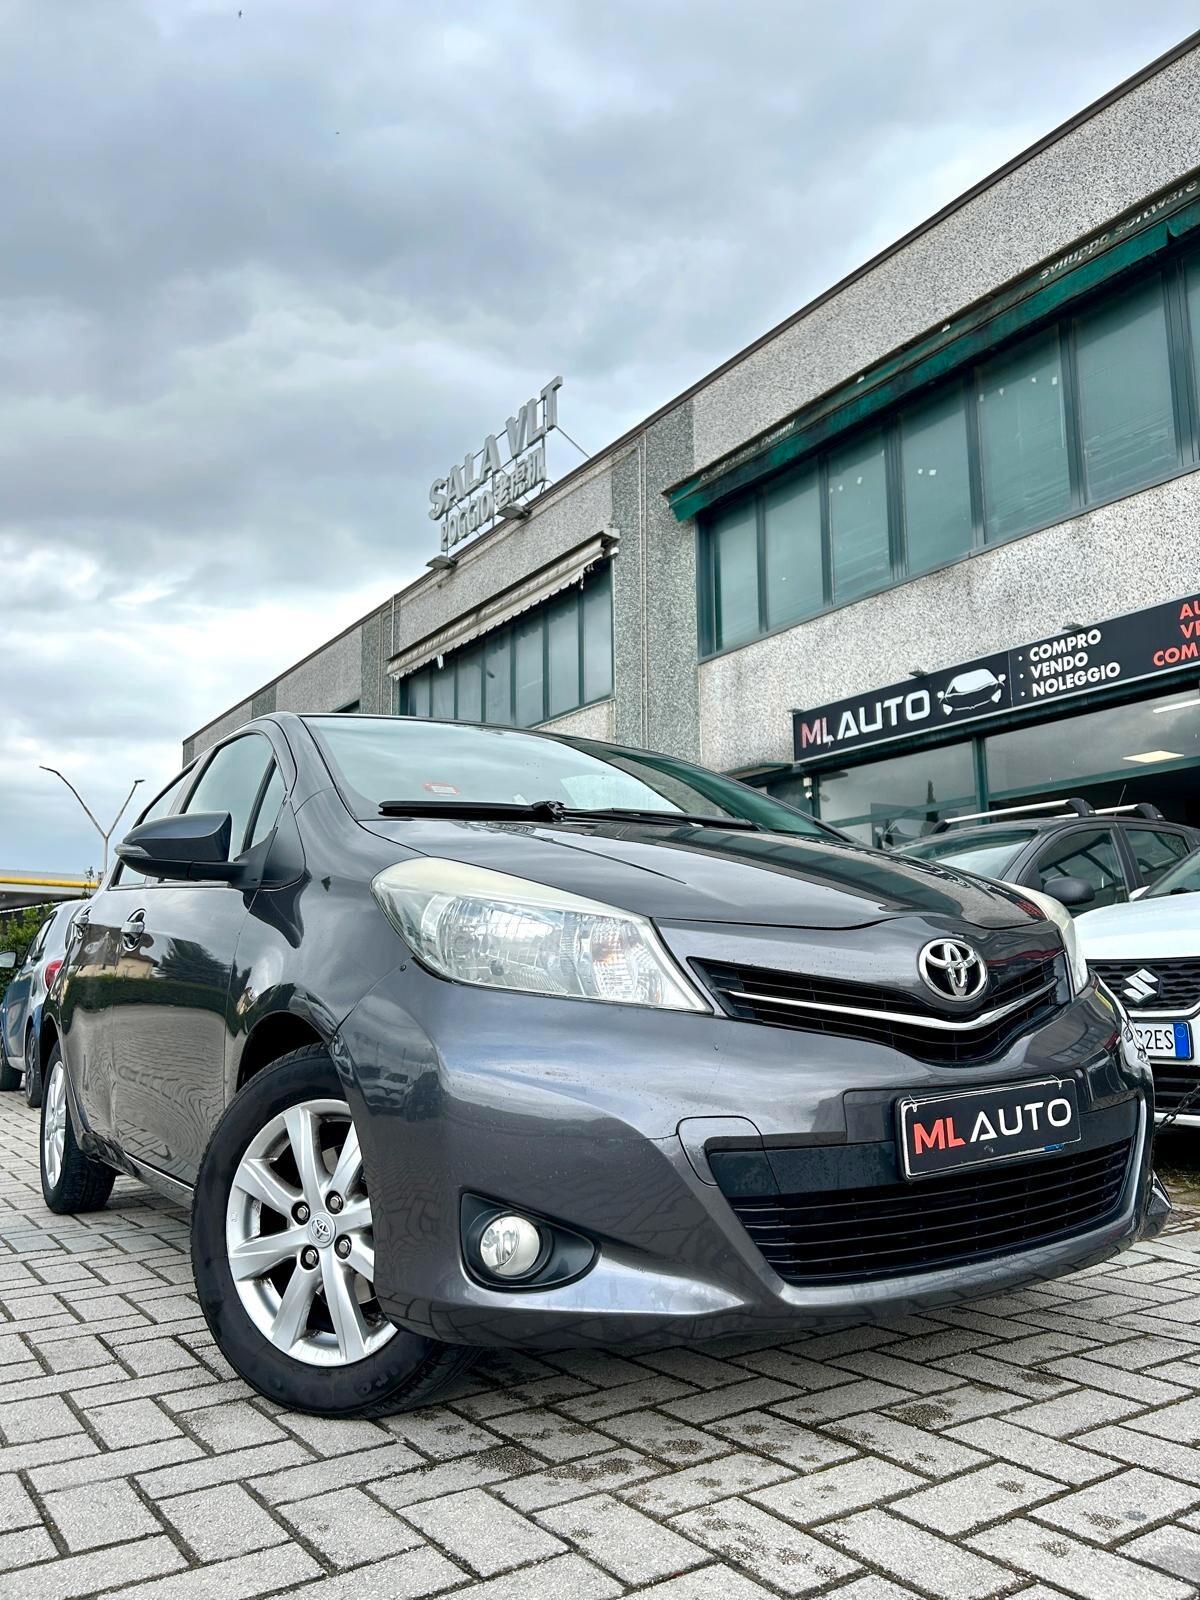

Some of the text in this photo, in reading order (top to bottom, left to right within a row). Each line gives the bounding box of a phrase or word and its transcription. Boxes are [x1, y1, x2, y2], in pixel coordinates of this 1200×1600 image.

[1039, 179, 1198, 280] Sviluppo Software
[428, 375, 563, 521] SALA VLT
[440, 490, 493, 552] POGGIO
[1029, 628, 1102, 662] COMPRO
[1030, 652, 1089, 679] VENDO
[1031, 662, 1121, 698] NOLEGGIO
